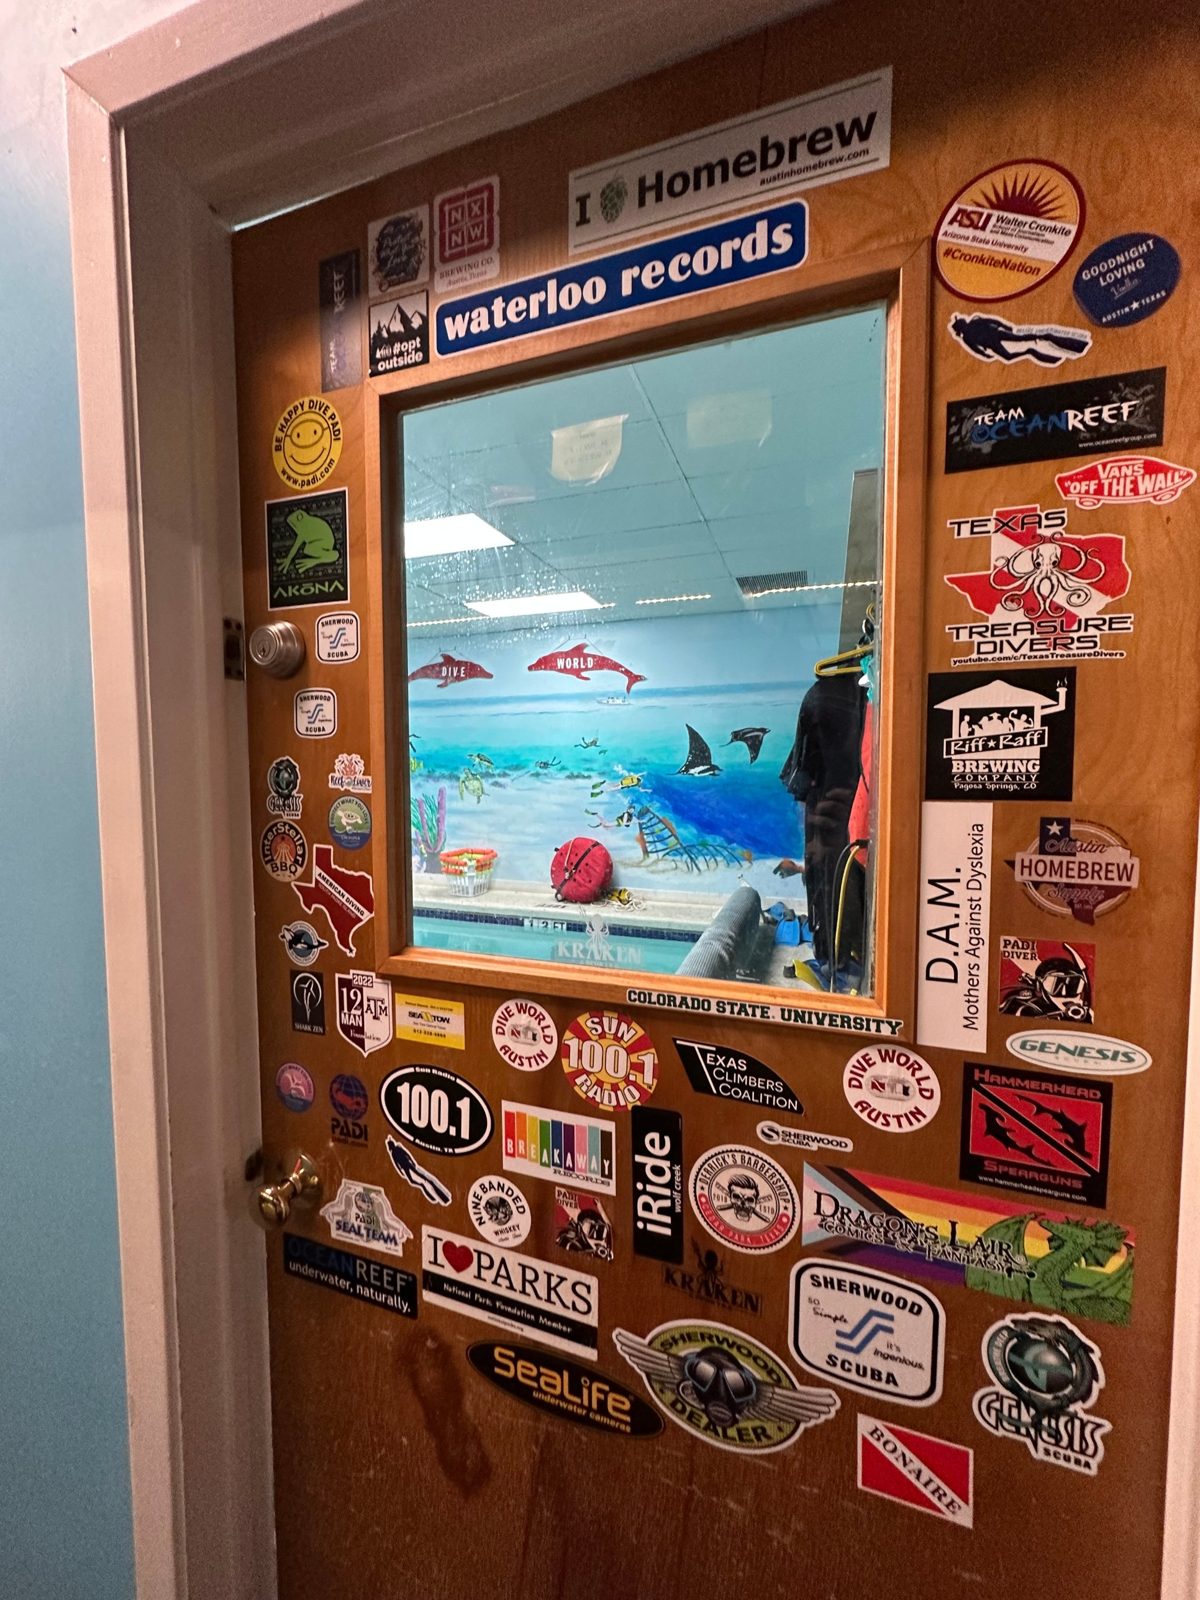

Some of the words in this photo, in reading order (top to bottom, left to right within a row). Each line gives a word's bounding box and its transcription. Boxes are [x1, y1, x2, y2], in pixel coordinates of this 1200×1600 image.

[575, 192, 591, 227] I
[637, 110, 878, 208] Homebrew
[759, 148, 870, 187] austinhomebrew.com
[947, 207, 993, 232] ASU
[994, 213, 1028, 230] Walter
[1028, 220, 1072, 238] Cronkite
[941, 230, 969, 242] Arizona
[970, 236, 991, 245] State
[990, 239, 1029, 253] University
[439, 260, 480, 280] BREWING
[942, 248, 1042, 277] #CronkiteNation
[1081, 238, 1156, 282] GOODNIGHT
[1099, 259, 1146, 287] LOVING
[444, 275, 607, 342] waterloo
[620, 218, 794, 298] records
[1101, 306, 1131, 324] AUSTIN
[1141, 289, 1167, 305] TEXAS
[392, 335, 422, 355] #opt
[377, 350, 424, 372] outside
[278, 399, 306, 431] HAPPY
[308, 398, 330, 417] DIVE
[969, 399, 1141, 444] OCEANREEF
[973, 406, 1025, 426] TEAM
[327, 411, 342, 442] PADI
[274, 436, 283, 452] BE
[280, 457, 336, 489] www.padi.com
[1096, 459, 1145, 480] VANS
[1100, 477, 1134, 497] THE
[948, 509, 1067, 538] TEXAS
[320, 618, 354, 628] SHERWOOD
[947, 614, 1133, 641] TREASURE
[327, 650, 349, 658] SCUBA
[952, 650, 1126, 665] youtube.com/c/TexasTreasureDivers
[975, 633, 1099, 656] DIVERS
[441, 665, 467, 679] DIVE
[556, 657, 595, 670] WORLD
[950, 736, 987, 755] Riff
[999, 730, 1043, 750] Raff
[951, 759, 1041, 773] BREWING
[953, 773, 1038, 782] COMPANY
[953, 782, 983, 791] Pagosa
[985, 782, 1020, 791] Springs,
[1023, 782, 1037, 790] CO
[263, 821, 305, 865] InterStellar
[966, 822, 987, 891] Dyslexia
[1044, 837, 1109, 855] Austin
[270, 861, 298, 875] BBQ
[1019, 857, 1135, 883] HOMEBREW
[317, 872, 346, 899] AMERICAN
[345, 897, 365, 917] DIVING
[925, 867, 962, 984] D.A.M.
[964, 895, 985, 959] Against
[1002, 938, 1036, 951] PADI
[1002, 950, 1039, 961] DIVER
[352, 974, 374, 986] 2022
[962, 962, 981, 1031] Mothers
[340, 1012, 363, 1027] MAN
[407, 1010, 424, 1019] SEA
[433, 1015, 451, 1025] TOW
[495, 1005, 515, 1037] DIVE
[514, 1001, 554, 1045] WORLD
[627, 989, 713, 1013] COLORADO
[715, 999, 772, 1020] STATE
[780, 1006, 903, 1035] UNIVERSITY
[294, 1023, 312, 1032] SHARK
[312, 1024, 324, 1034] ZEN
[585, 1015, 637, 1043] SUN
[499, 1044, 549, 1068] AUSTIN
[563, 1036, 656, 1086] 100.1
[1019, 1039, 1137, 1064] GENESIS
[414, 1066, 431, 1074] Sun
[431, 1068, 456, 1082] Radio
[711, 1067, 784, 1094] CLIMBERS
[847, 1052, 877, 1090] DIVE
[876, 1047, 935, 1101] WORLD
[973, 1068, 1102, 1100] HAMMERHEAD
[574, 1073, 641, 1107] RADIO
[718, 1083, 799, 1112] COALITION
[396, 1081, 471, 1141] 100.1
[853, 1099, 928, 1130] AUSTIN
[330, 1117, 369, 1140] PADI
[780, 1129, 849, 1149] SHERWOOD
[780, 1137, 812, 1148] SCUBA
[506, 1137, 611, 1176] BREAKAWAY
[552, 1168, 611, 1187] RECORDS
[634, 1131, 673, 1237] iRide
[672, 1164, 682, 1190] creek
[697, 1153, 738, 1186] DERRICK'S
[740, 1153, 791, 1204] BARBERSHOP
[982, 1160, 1084, 1190] SPEARGUNS
[472, 1191, 487, 1227] NINE
[479, 1180, 527, 1216] BANDED
[673, 1189, 682, 1214] wolf
[354, 1212, 376, 1226] PADI
[813, 1190, 940, 1241] DRAGON'S
[335, 1219, 365, 1238] SEAL
[363, 1226, 399, 1247] TEAM
[493, 1224, 520, 1238] WHISKEY
[822, 1221, 886, 1244] COMICS
[288, 1260, 354, 1293] underwater,
[356, 1282, 412, 1314] naturally.
[426, 1233, 446, 1268] I
[472, 1247, 593, 1316] PARKS
[664, 1266, 760, 1313] KRAKEN
[809, 1273, 924, 1318] SHERWOOD
[443, 1282, 472, 1300] National
[496, 1300, 535, 1321] Foundation
[538, 1315, 572, 1334] Member
[812, 1306, 849, 1324] Simple
[659, 1331, 782, 1385] SHERWOOD
[825, 1353, 900, 1388] SCUBA
[532, 1390, 588, 1418] underwater
[588, 1411, 632, 1434] cameras
[669, 1399, 772, 1444] DEALER
[977, 1391, 1105, 1459] GENESIS
[866, 1424, 962, 1516] BONAIRE
[1043, 1448, 1092, 1471] SCUBA
